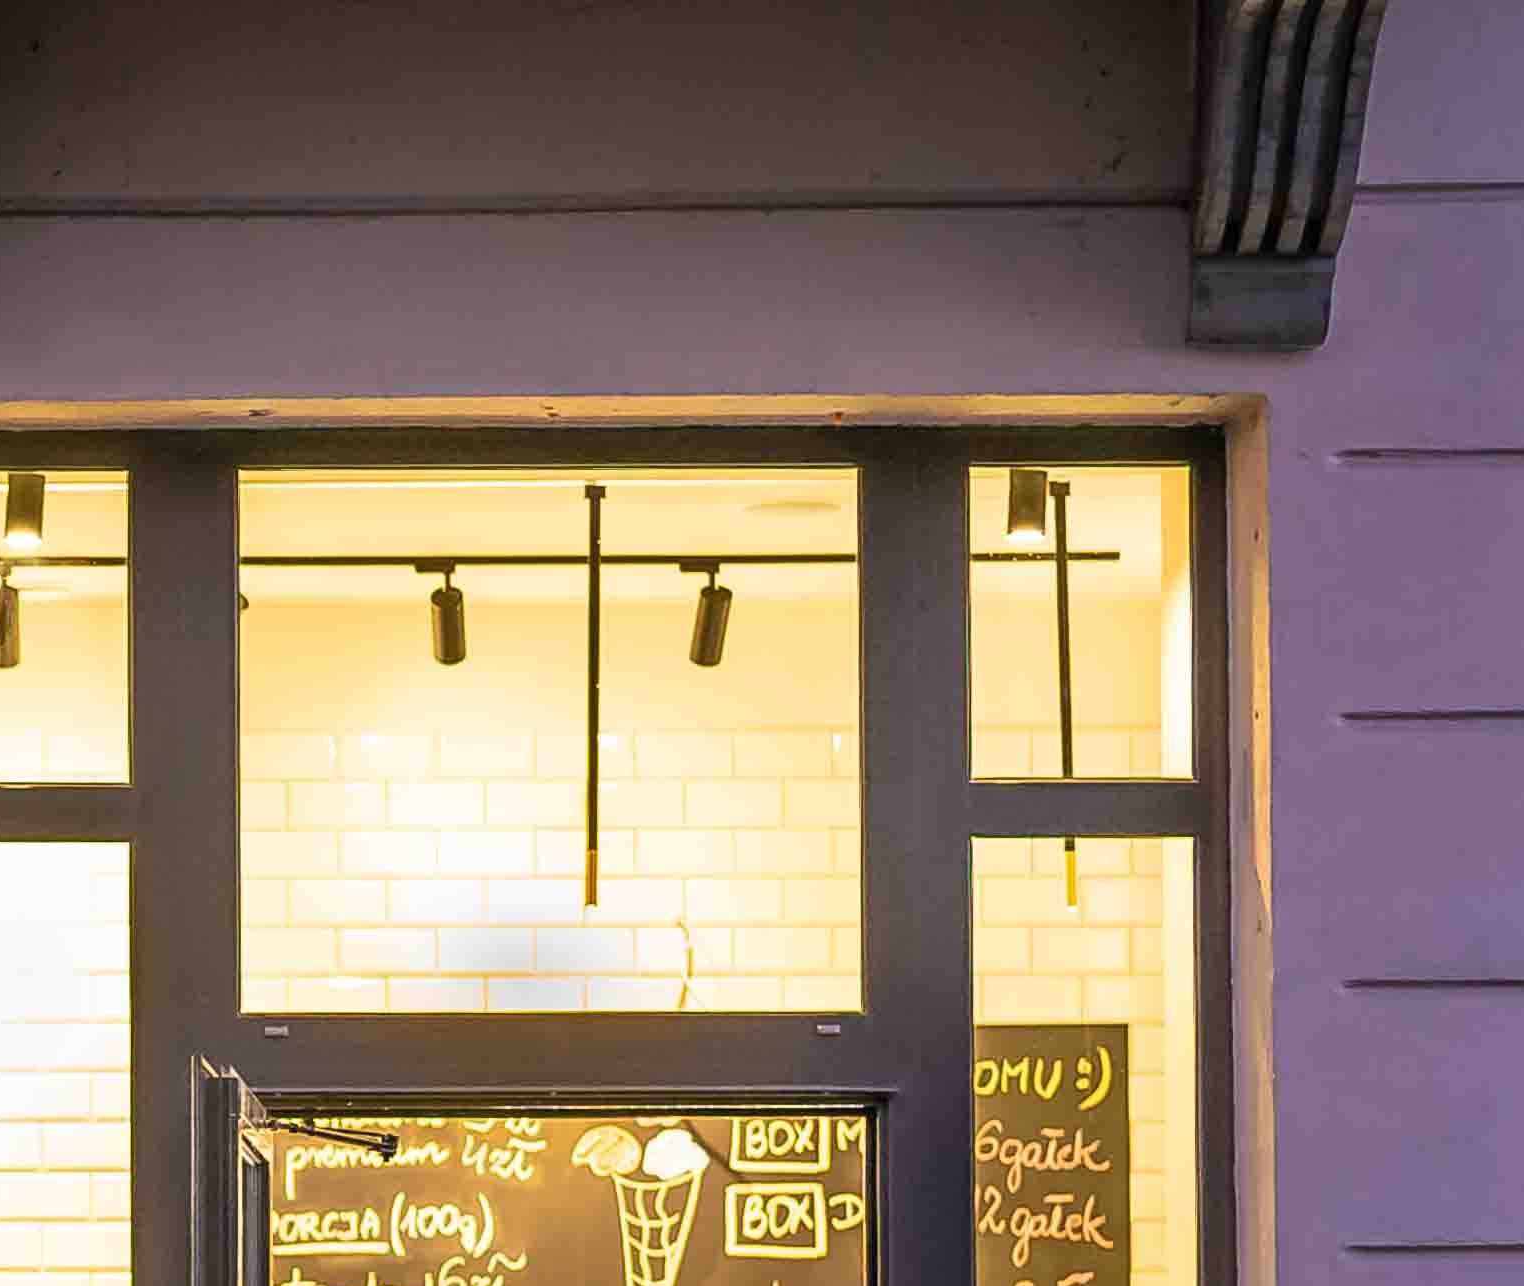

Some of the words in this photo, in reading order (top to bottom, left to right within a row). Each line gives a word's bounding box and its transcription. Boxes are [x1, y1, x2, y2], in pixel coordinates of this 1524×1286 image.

[745, 1118, 816, 1159] BOX
[284, 1143, 451, 1201] premum
[741, 1194, 815, 1241] BOX
